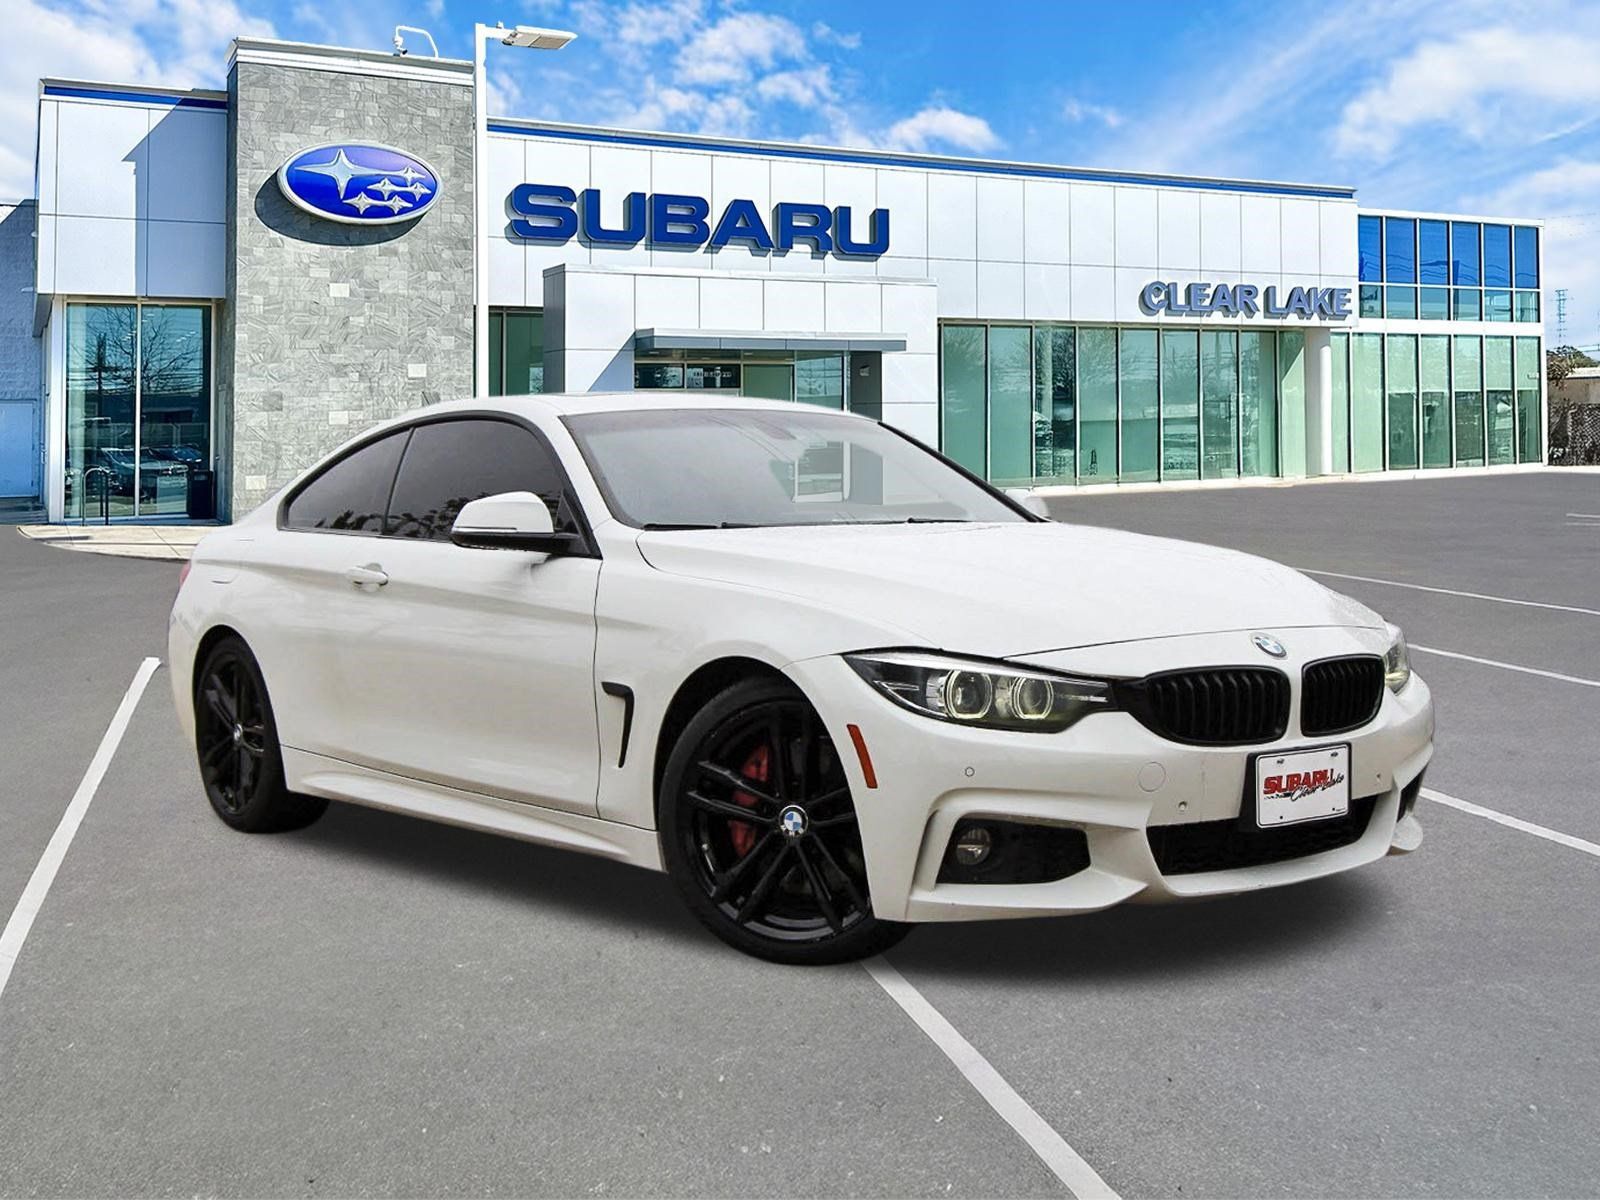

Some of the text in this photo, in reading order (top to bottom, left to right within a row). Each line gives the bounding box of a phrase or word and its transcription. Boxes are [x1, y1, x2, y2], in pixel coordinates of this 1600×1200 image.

[506, 183, 890, 260] SUBARU
[1139, 281, 1353, 320] CLEAR LAKE
[1263, 768, 1334, 795] SUBARU
